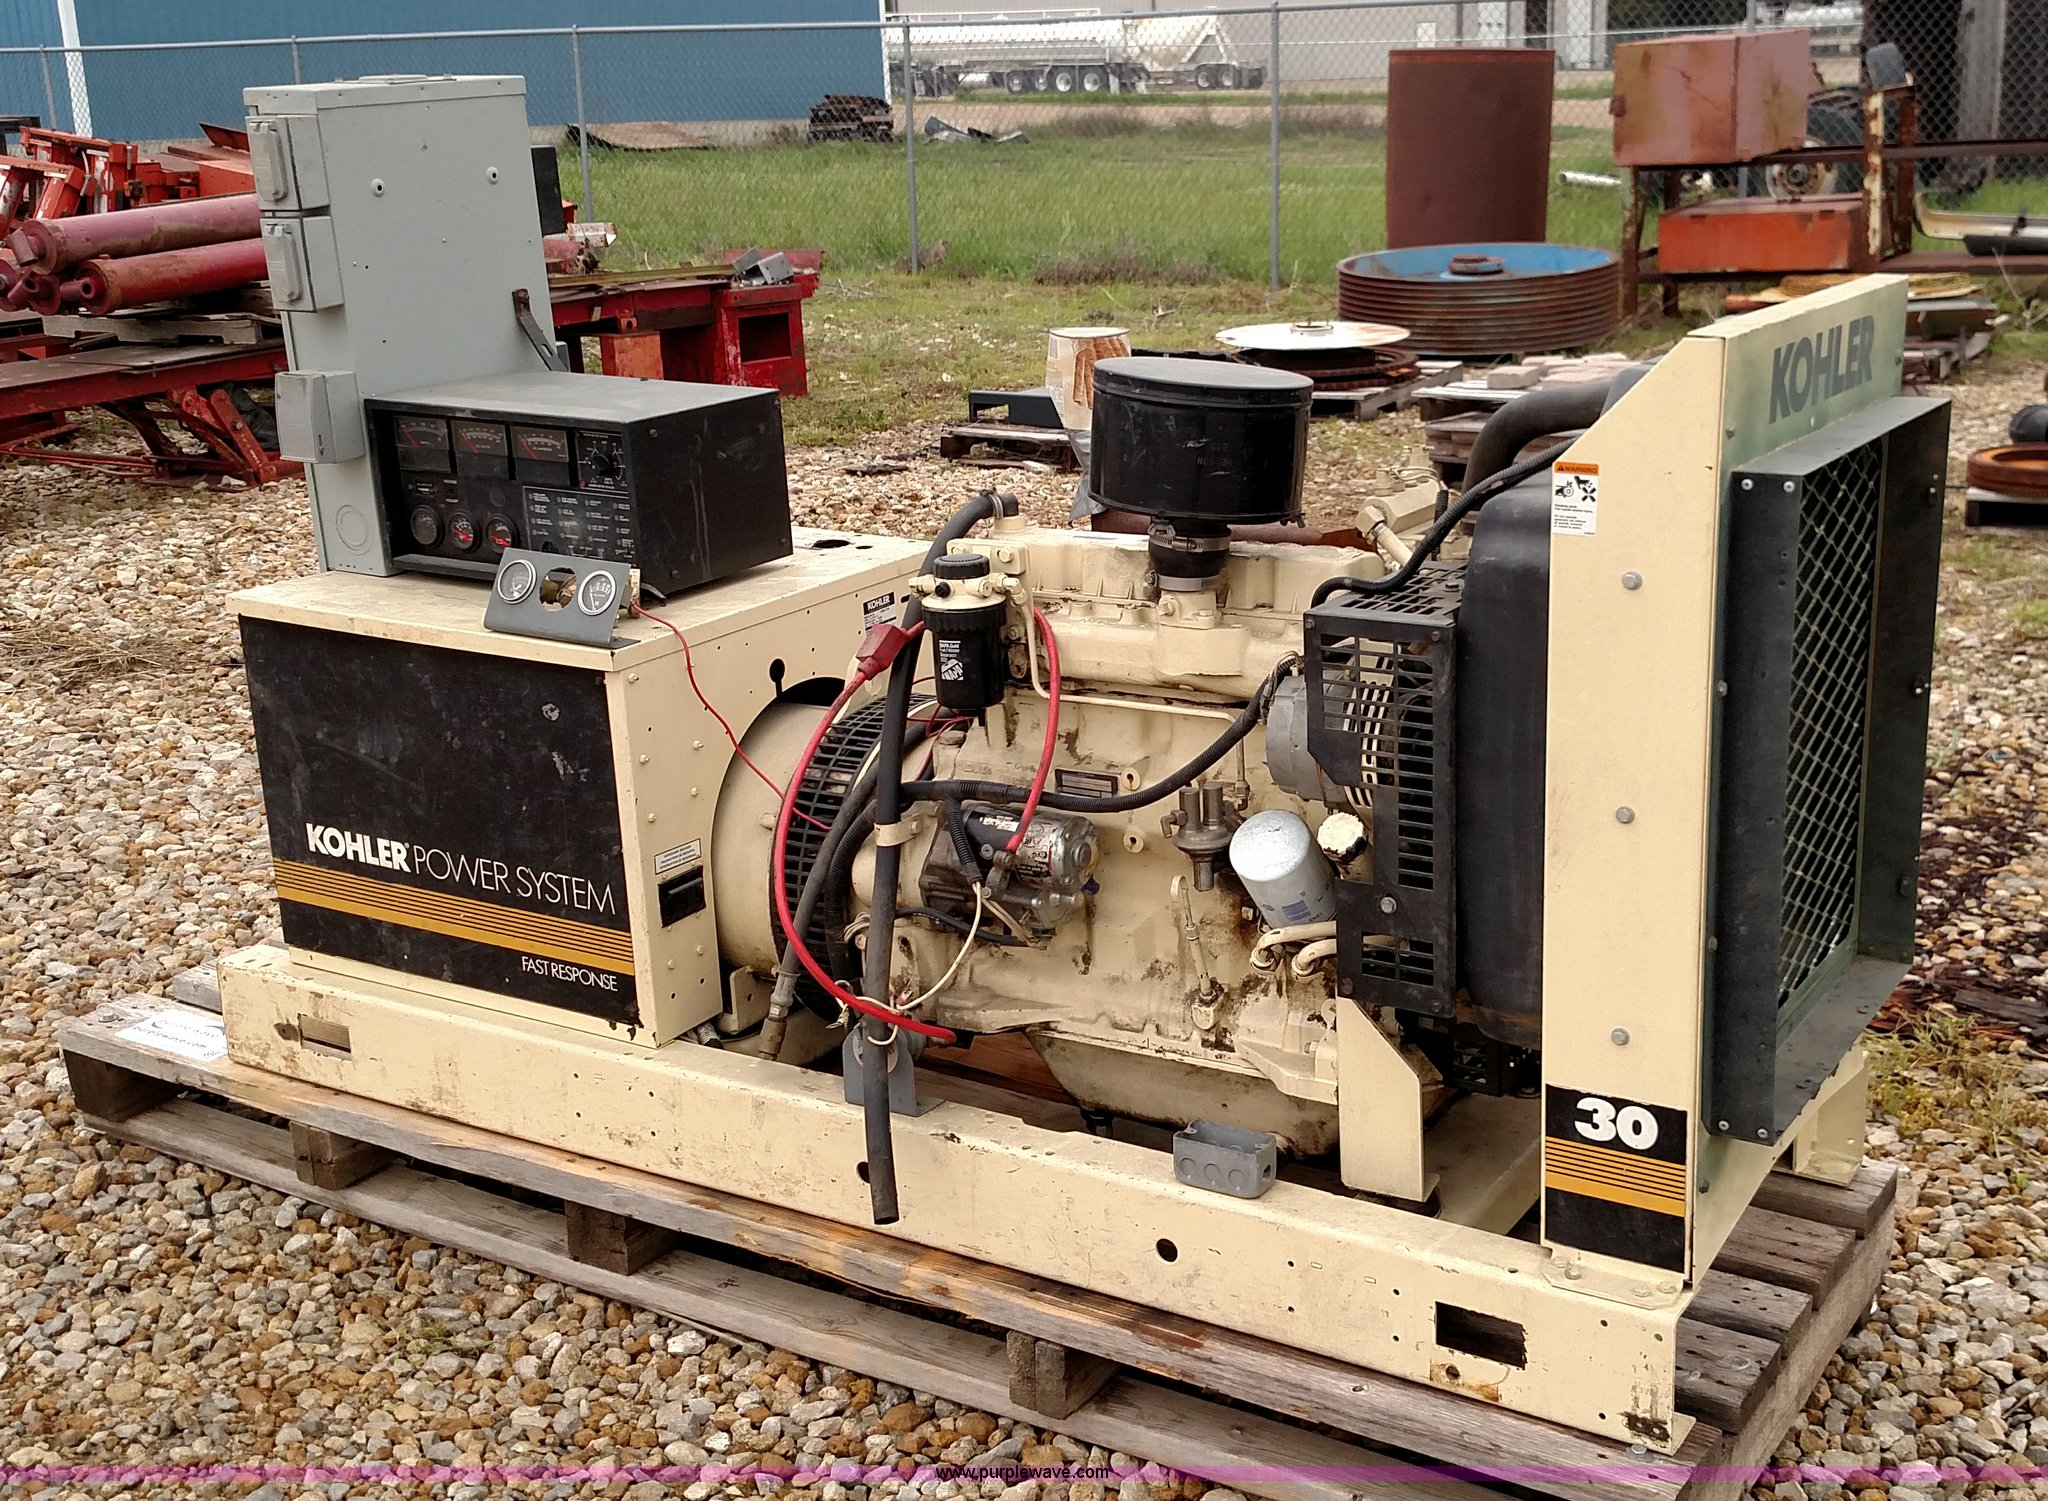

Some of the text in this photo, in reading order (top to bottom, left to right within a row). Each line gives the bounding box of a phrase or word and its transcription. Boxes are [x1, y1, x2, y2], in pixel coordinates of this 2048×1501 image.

[1768, 315, 1874, 425] KOHLER
[1564, 465, 1597, 475] WARNING
[867, 595, 890, 611] KOHLER
[943, 663, 963, 681] NAPA
[413, 845, 511, 894] POWER
[516, 866, 616, 915] SYSTEM
[521, 956, 618, 992] FAST RESPONSE
[1574, 1097, 1658, 1150] 30
